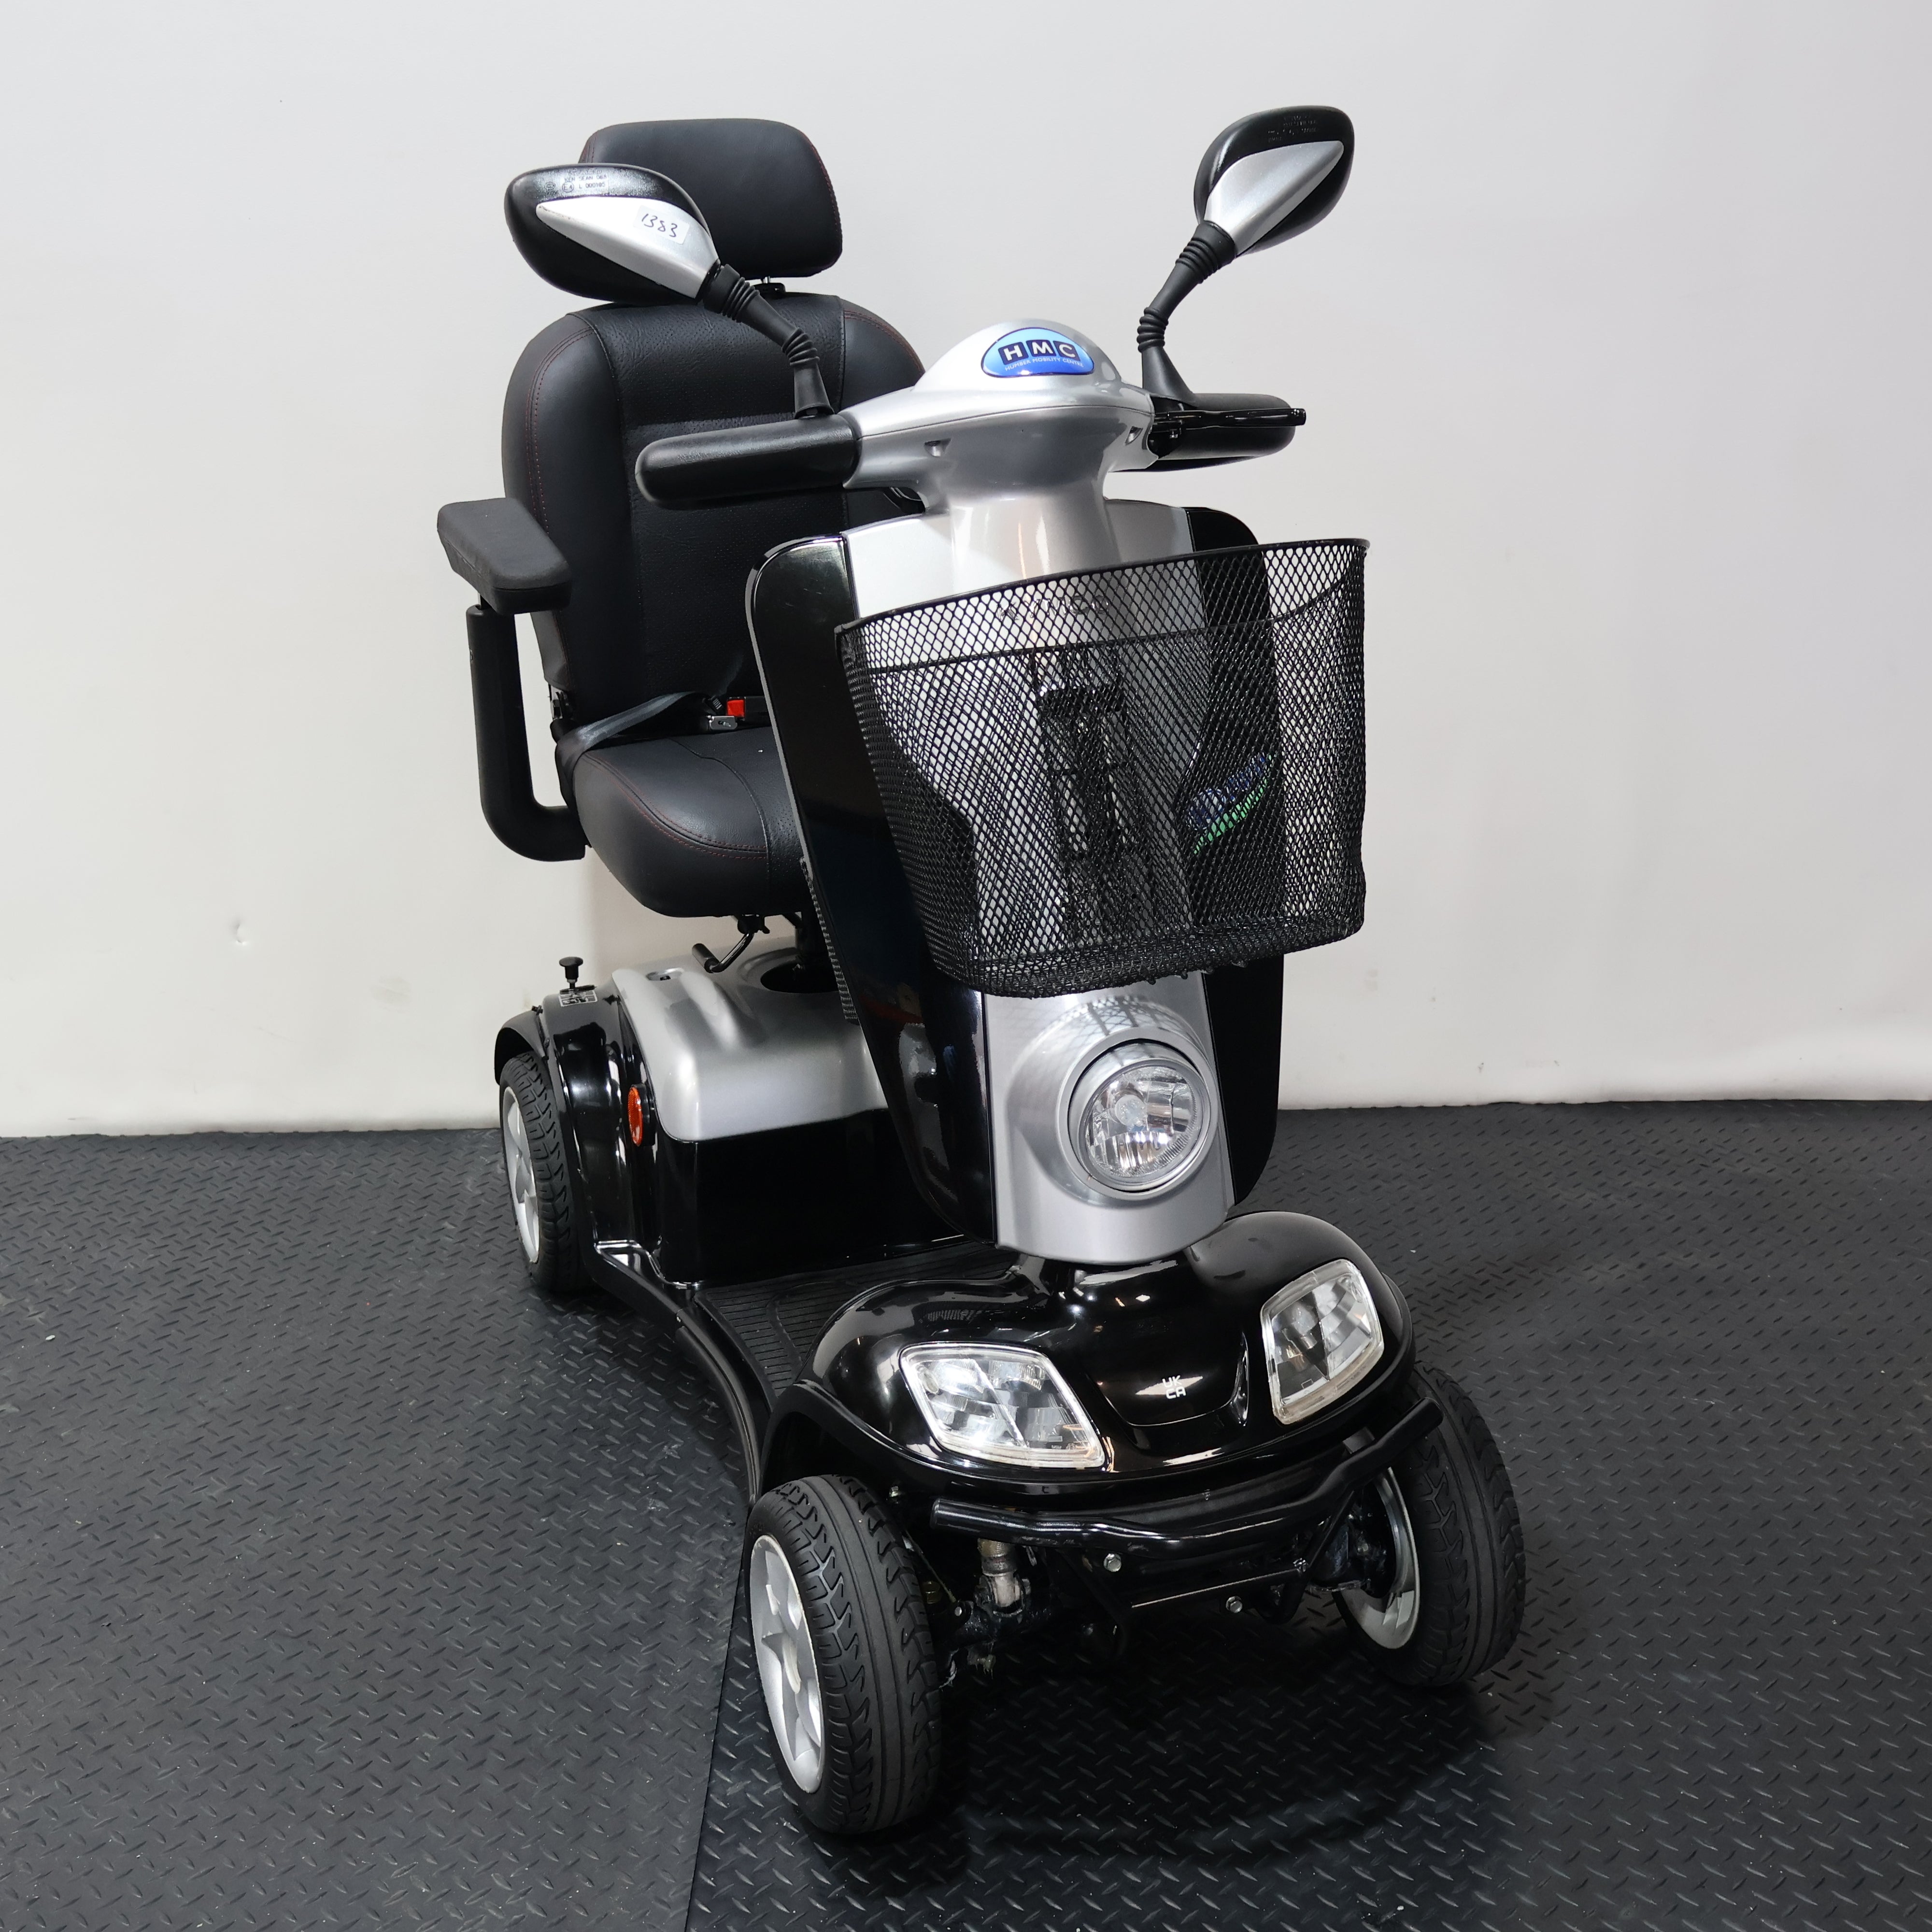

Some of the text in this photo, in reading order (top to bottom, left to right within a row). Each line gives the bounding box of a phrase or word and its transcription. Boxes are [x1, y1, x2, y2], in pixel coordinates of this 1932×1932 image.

[641, 213, 678, 237] 1383
[1002, 341, 1076, 361] HMC
[1005, 360, 1031, 371] HUMBER
[1063, 358, 1084, 367] CENTRE
[1162, 1375, 1182, 1388] UK
[1166, 1387, 1186, 1399] CA
